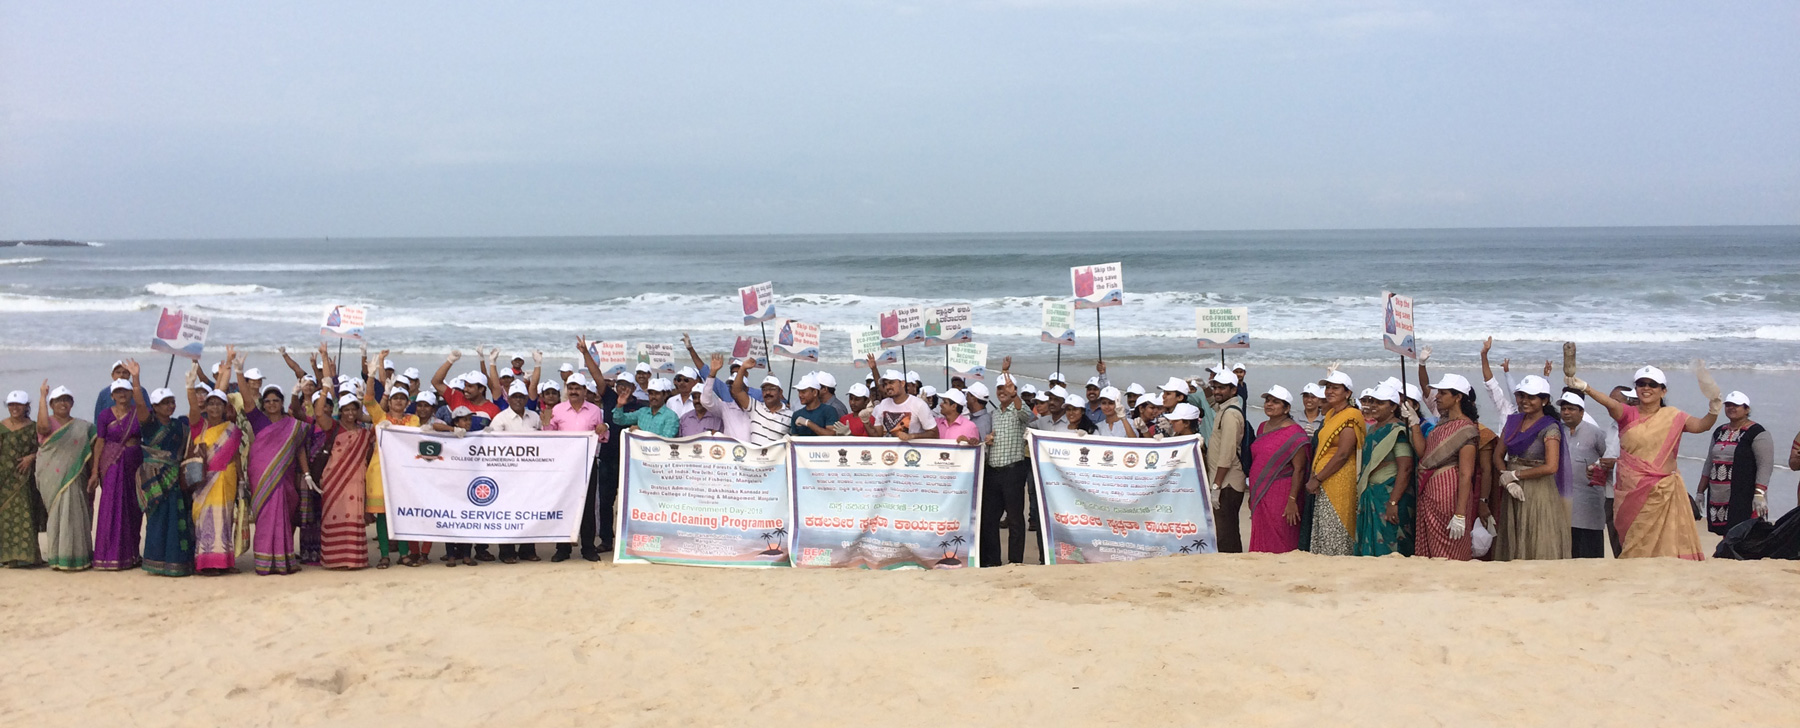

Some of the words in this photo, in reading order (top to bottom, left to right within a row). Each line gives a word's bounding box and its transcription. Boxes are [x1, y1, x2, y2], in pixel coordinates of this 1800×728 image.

[426, 444, 434, 455] S
[469, 445, 539, 456] SAHYADRI
[397, 507, 456, 519] NATIONAL
[460, 510, 510, 520] SERVICE
[514, 510, 564, 520] SCHEME
[682, 504, 728, 513] Environment
[632, 508, 668, 522] Beach
[671, 512, 718, 528] Cleaning
[721, 516, 783, 530] Programme
[436, 521, 481, 530] SAHYADRI
[484, 522, 502, 530] NSS
[805, 516, 854, 528] ಕಡಲತೀರ
[894, 518, 960, 535] ಕಾರ್ಯಕ್ರಮ
[1054, 512, 1102, 526] ಕಡಲತೀರ
[1144, 520, 1197, 539] ಕಾರ್ಯಕ್ರಮ
[633, 534, 662, 543] BEAT
[804, 548, 832, 556] BEAT
